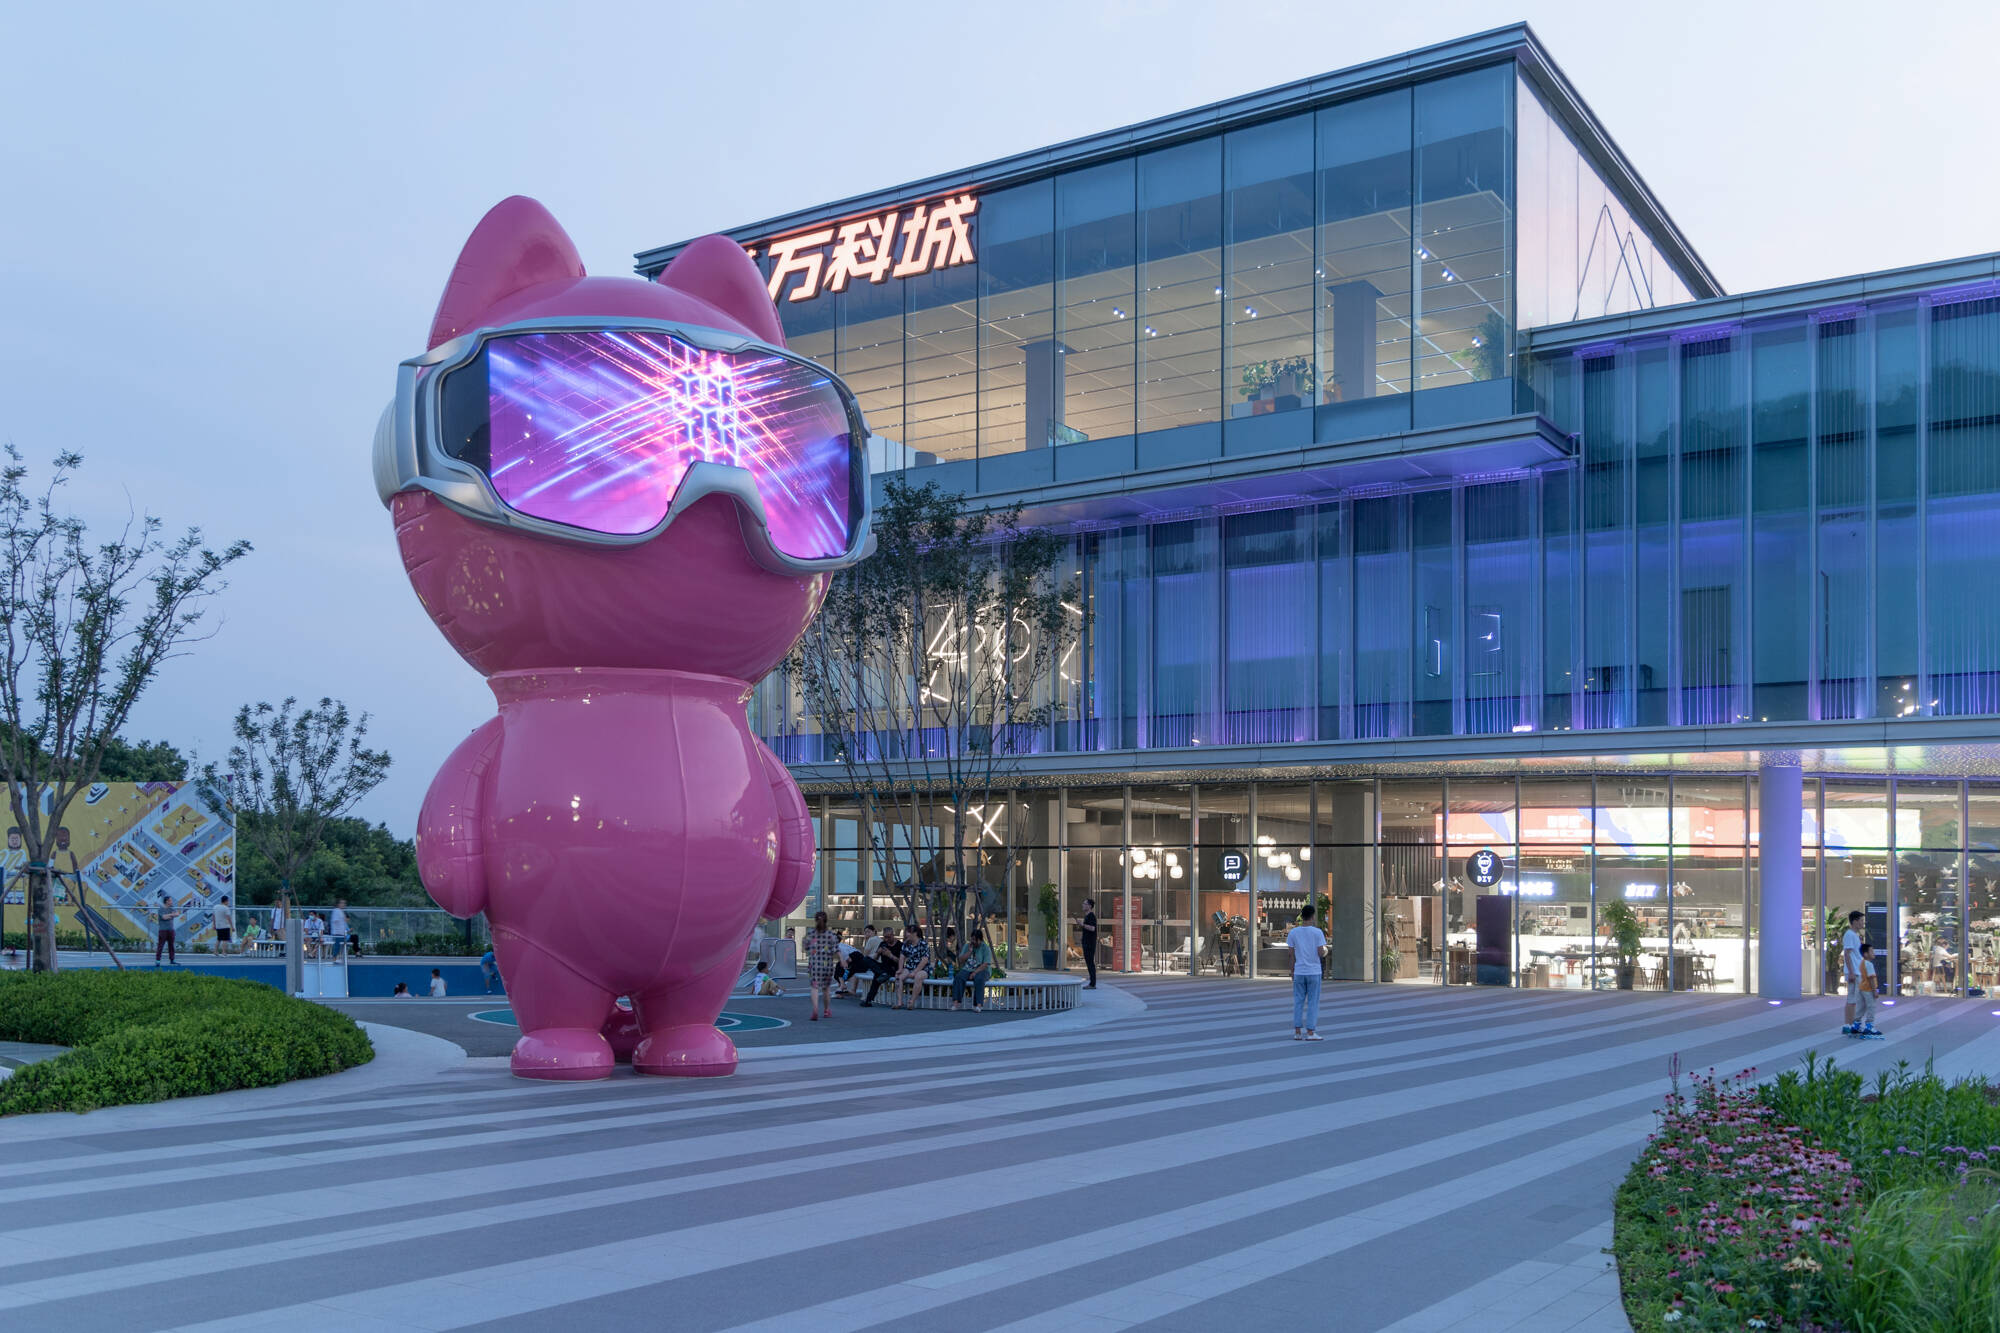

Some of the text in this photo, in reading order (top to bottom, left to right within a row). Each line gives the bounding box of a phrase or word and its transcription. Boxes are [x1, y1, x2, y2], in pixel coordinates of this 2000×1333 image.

[747, 195, 979, 302] 万科城
[1476, 875, 1492, 883] DIY
